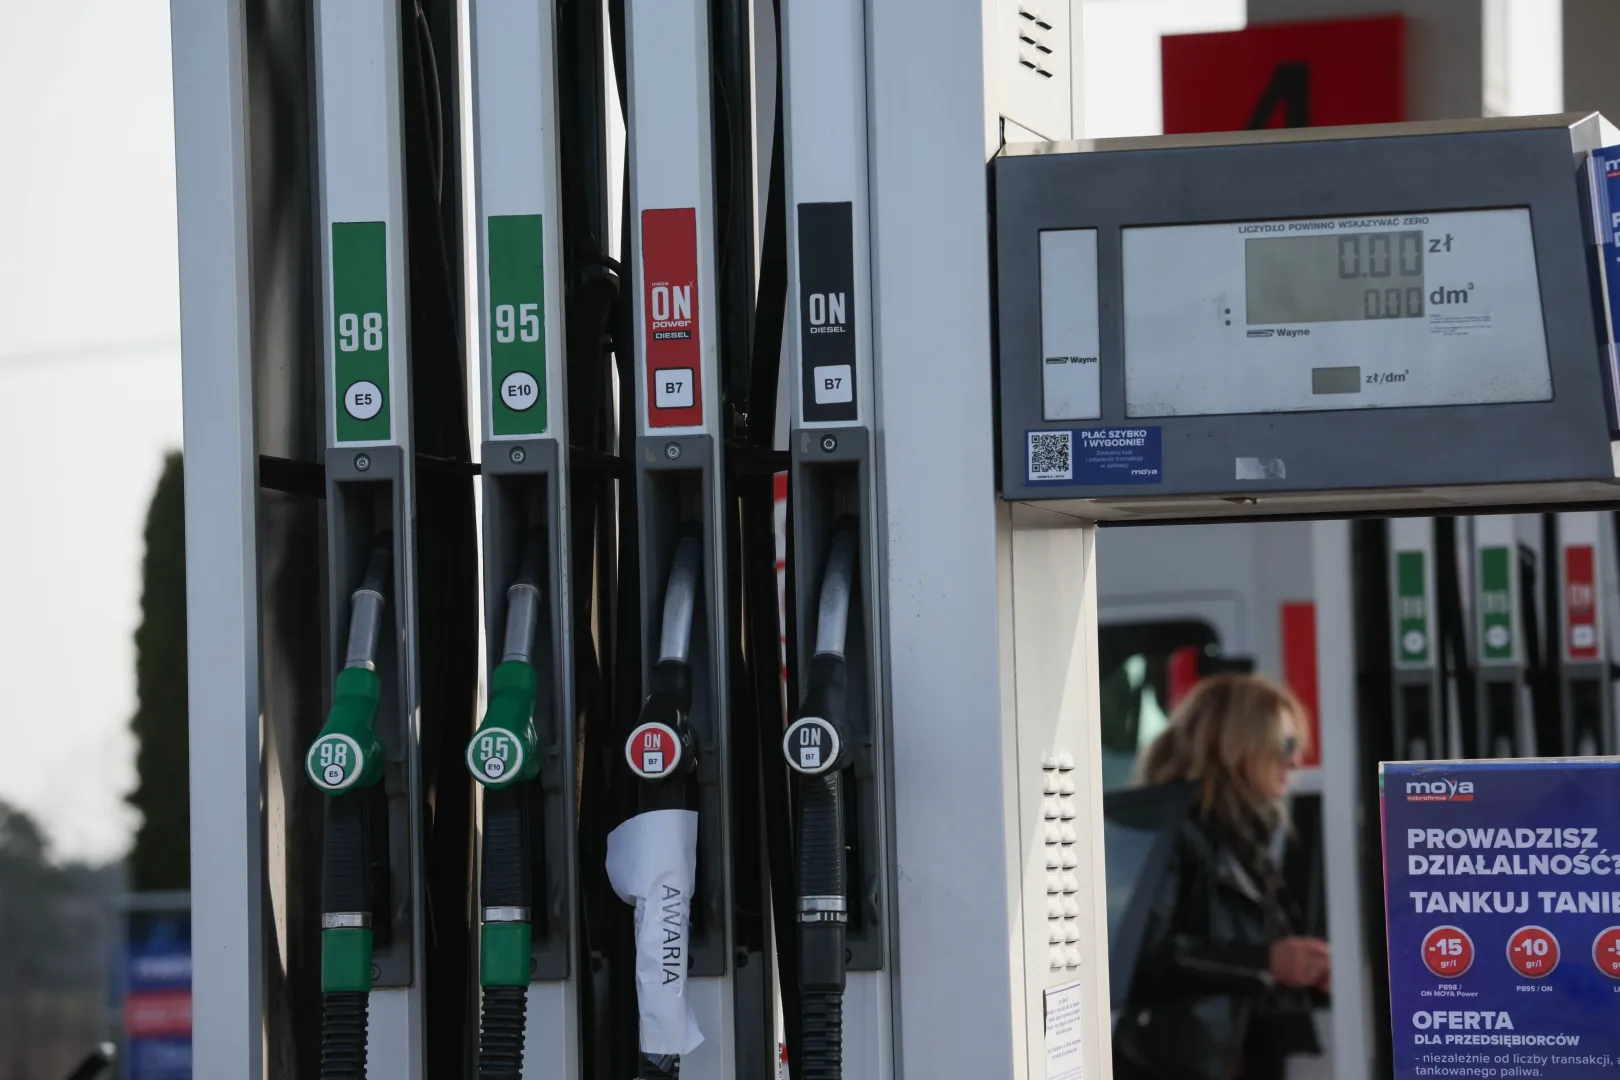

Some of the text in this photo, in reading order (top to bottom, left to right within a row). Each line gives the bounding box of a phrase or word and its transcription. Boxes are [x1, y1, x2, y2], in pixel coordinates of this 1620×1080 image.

[1238, 217, 1430, 234] LICZYDŁO POWINNO WSKAZYWAĆ ZERO
[1428, 233, 1454, 253] zł
[1338, 233, 1423, 279] 0.00
[652, 285, 692, 321] ON
[809, 292, 846, 326] ON
[1364, 287, 1423, 320] 0.00
[495, 303, 540, 343] 95
[652, 320, 692, 330] power
[810, 326, 846, 334] DIESEL
[339, 312, 383, 352] 98
[655, 331, 690, 339] DIESEL
[1276, 328, 1310, 338] Wayne
[1069, 356, 1097, 365] Wayne
[507, 384, 531, 397] E10
[665, 382, 683, 394] B7
[824, 378, 842, 390] B7
[354, 393, 373, 406] E5
[1081, 429, 1147, 439] PŁAĆ SZYBKO
[1084, 438, 1145, 448] I WYGODNIE!
[1131, 468, 1158, 476] moya
[644, 733, 661, 748] ON
[800, 727, 821, 746] ON
[320, 743, 348, 767] 98
[480, 736, 509, 762] 95
[805, 753, 815, 761] B7
[329, 770, 339, 778] E5
[488, 763, 501, 771] E10
[1406, 777, 1474, 800] moya
[1407, 828, 1599, 849] PROWADZISZ
[1408, 848, 1620, 876] DZIAŁALNOŚĆ?
[1409, 891, 1530, 914] TANKUJ
[661, 884, 682, 986] AWARIA
[1428, 938, 1463, 956] -15
[1514, 938, 1549, 956] -10
[1440, 960, 1457, 969] gr/l
[1525, 960, 1542, 969] gr/l
[1412, 1010, 1515, 1030] OFERTA
[1414, 1033, 1580, 1047] DLA PRZEDSIĘBIORCÓW
[1423, 1053, 1490, 1063] niezależnie
[1494, 1053, 1509, 1064] od
[1513, 1054, 1548, 1066] liczby
[1551, 1054, 1614, 1067] transakcji,
[1415, 1066, 1543, 1078] tankowanego paliwa.
